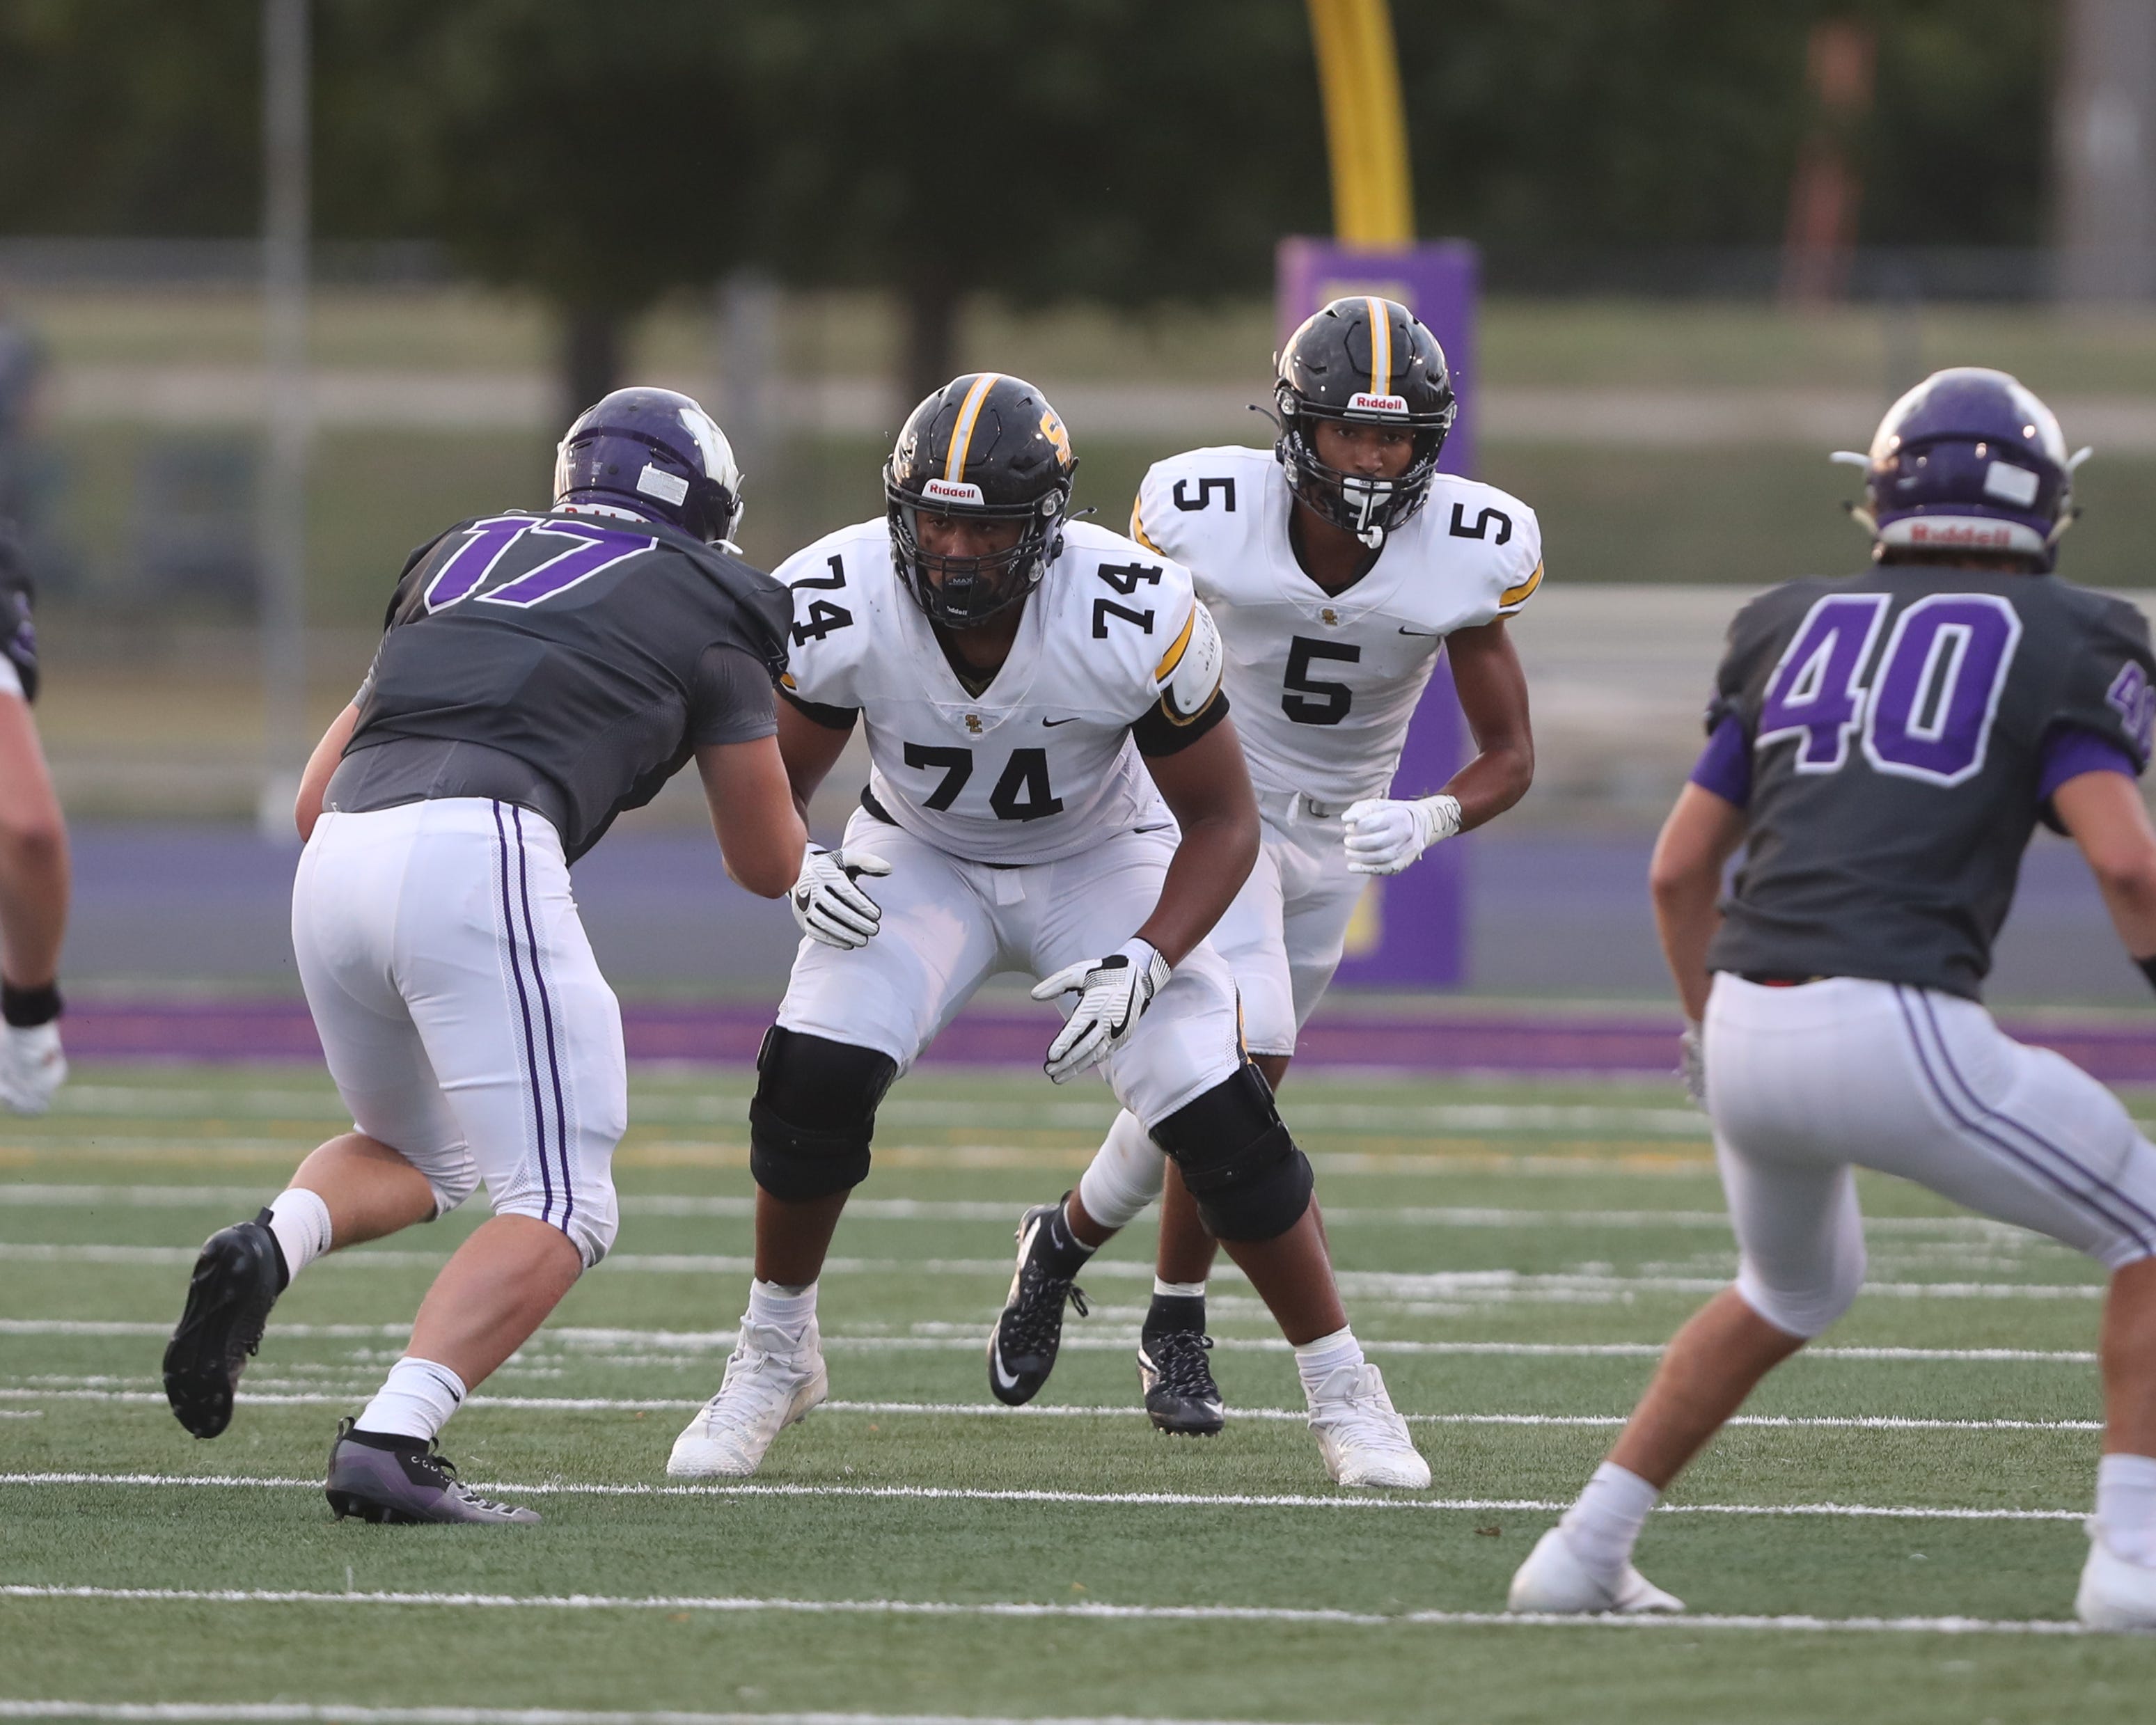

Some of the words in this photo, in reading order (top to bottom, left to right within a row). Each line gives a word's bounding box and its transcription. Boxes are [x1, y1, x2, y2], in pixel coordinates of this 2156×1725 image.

[1356, 397, 1402, 410] Riddell
[929, 483, 975, 498] Riddell
[1173, 477, 1236, 512] 5
[1449, 503, 1512, 546] 5
[423, 515, 659, 615] 17
[790, 554, 853, 647] 74
[1092, 562, 1163, 639] 74
[946, 605, 968, 616] iddell
[1281, 635, 1361, 725] 5
[1755, 592, 2023, 788] 40
[904, 742, 1064, 823] 74
